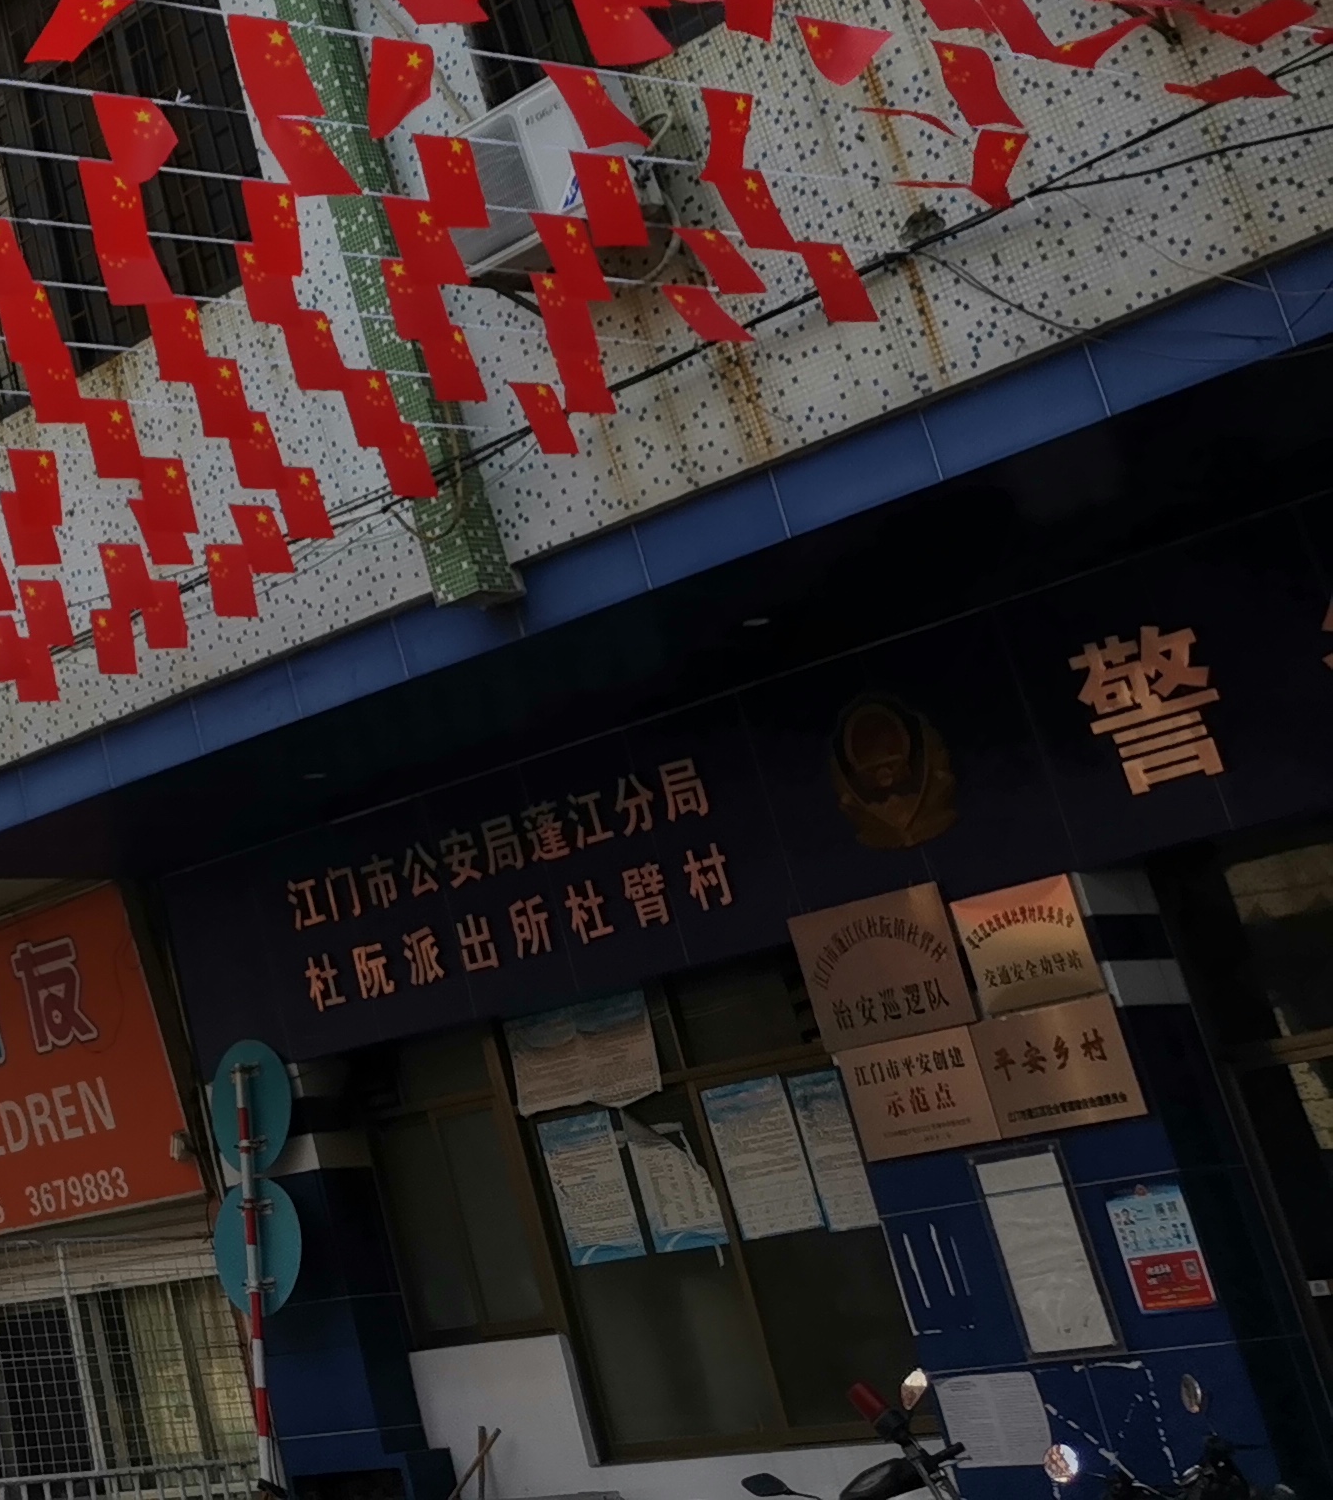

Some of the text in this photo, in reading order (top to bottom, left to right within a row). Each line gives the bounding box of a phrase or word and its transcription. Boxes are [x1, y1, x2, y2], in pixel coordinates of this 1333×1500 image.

[287, 756, 710, 931] 江门市公安局蓬江分局
[304, 842, 733, 1013] 杜阮派出所杜臂村
[983, 949, 1085, 989] 交通安全劝导站
[832, 977, 950, 1031] 治安巡逻队
[854, 1046, 966, 1087] 江门市平安创建
[994, 1027, 1108, 1082] 平安乡村
[885, 1082, 956, 1118] 示范点
[25, 1167, 130, 1218] 3679883
